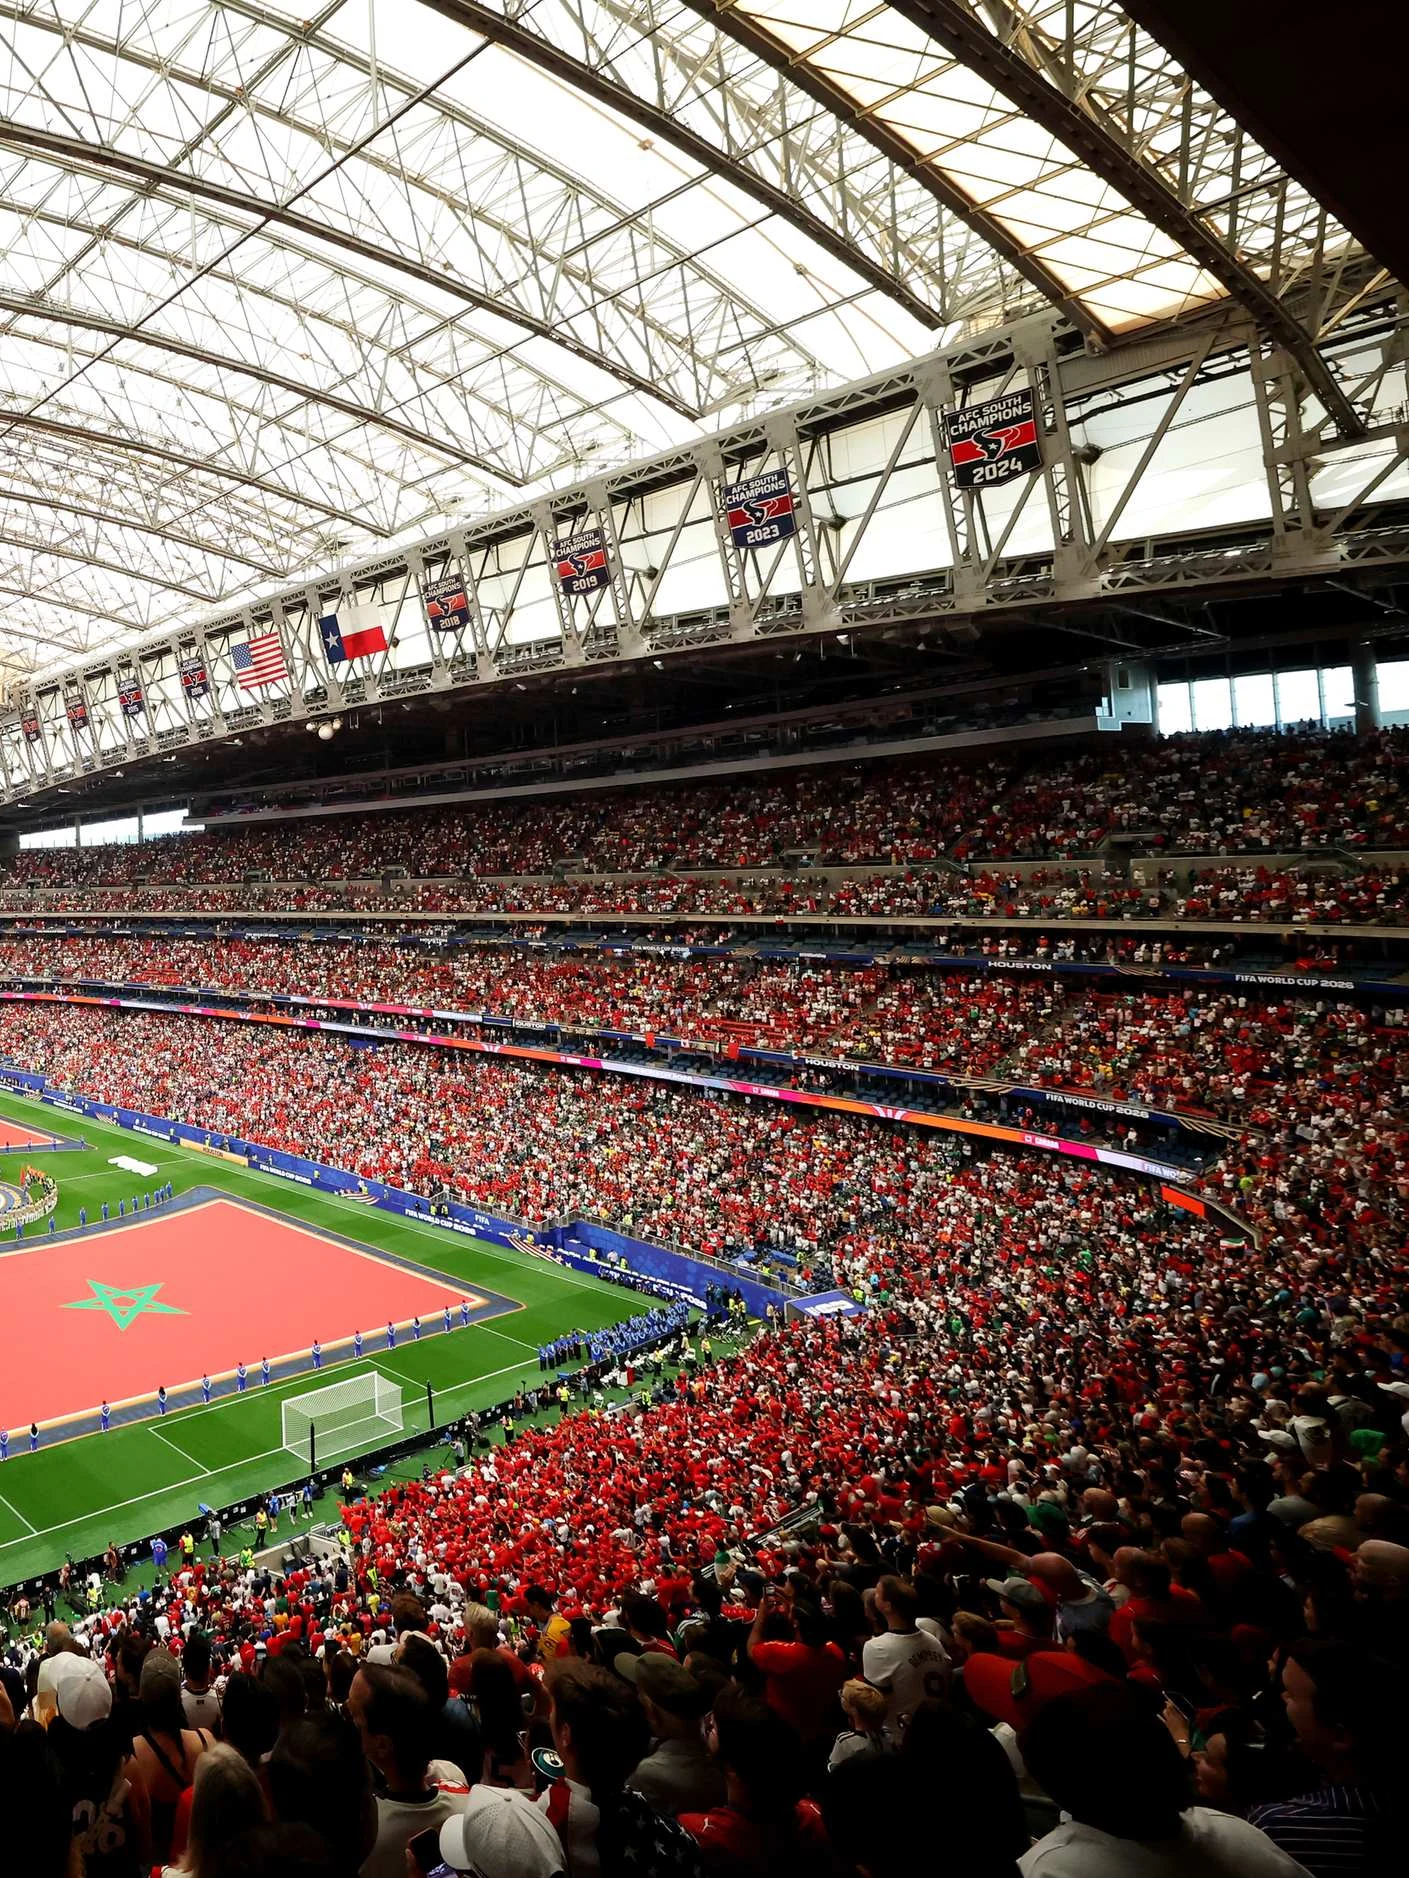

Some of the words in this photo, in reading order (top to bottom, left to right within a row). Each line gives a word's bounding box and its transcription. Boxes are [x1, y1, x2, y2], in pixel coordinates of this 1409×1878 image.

[950, 402, 1032, 436] CHAMPIONS
[958, 409, 980, 423] AFC
[982, 396, 1022, 415] SOUTH
[972, 457, 1023, 484] 2024
[726, 480, 786, 504] CHAMPIONS
[732, 484, 748, 494] AFC
[749, 474, 778, 488] SOUTH
[572, 532, 594, 544] SOUTH
[746, 525, 780, 544] 2023
[556, 537, 600, 557] CHAMPIONS
[572, 575, 598, 592] 2019
[439, 615, 461, 629] 2018
[988, 961, 1052, 970] HOUSTON
[1235, 974, 1257, 983] FIFA
[1257, 976, 1295, 985] WORLD
[1296, 978, 1318, 986] CUP
[1320, 979, 1355, 989] 2026
[805, 1058, 860, 1071] HOUSTON
[1046, 1093, 1064, 1103] FIFA
[1064, 1096, 1096, 1109] WORLD
[1096, 1102, 1115, 1112] CUP
[405, 1208, 418, 1218] FIFA
[440, 1219, 453, 1228] CUP
[475, 1214, 490, 1225] FIFA
